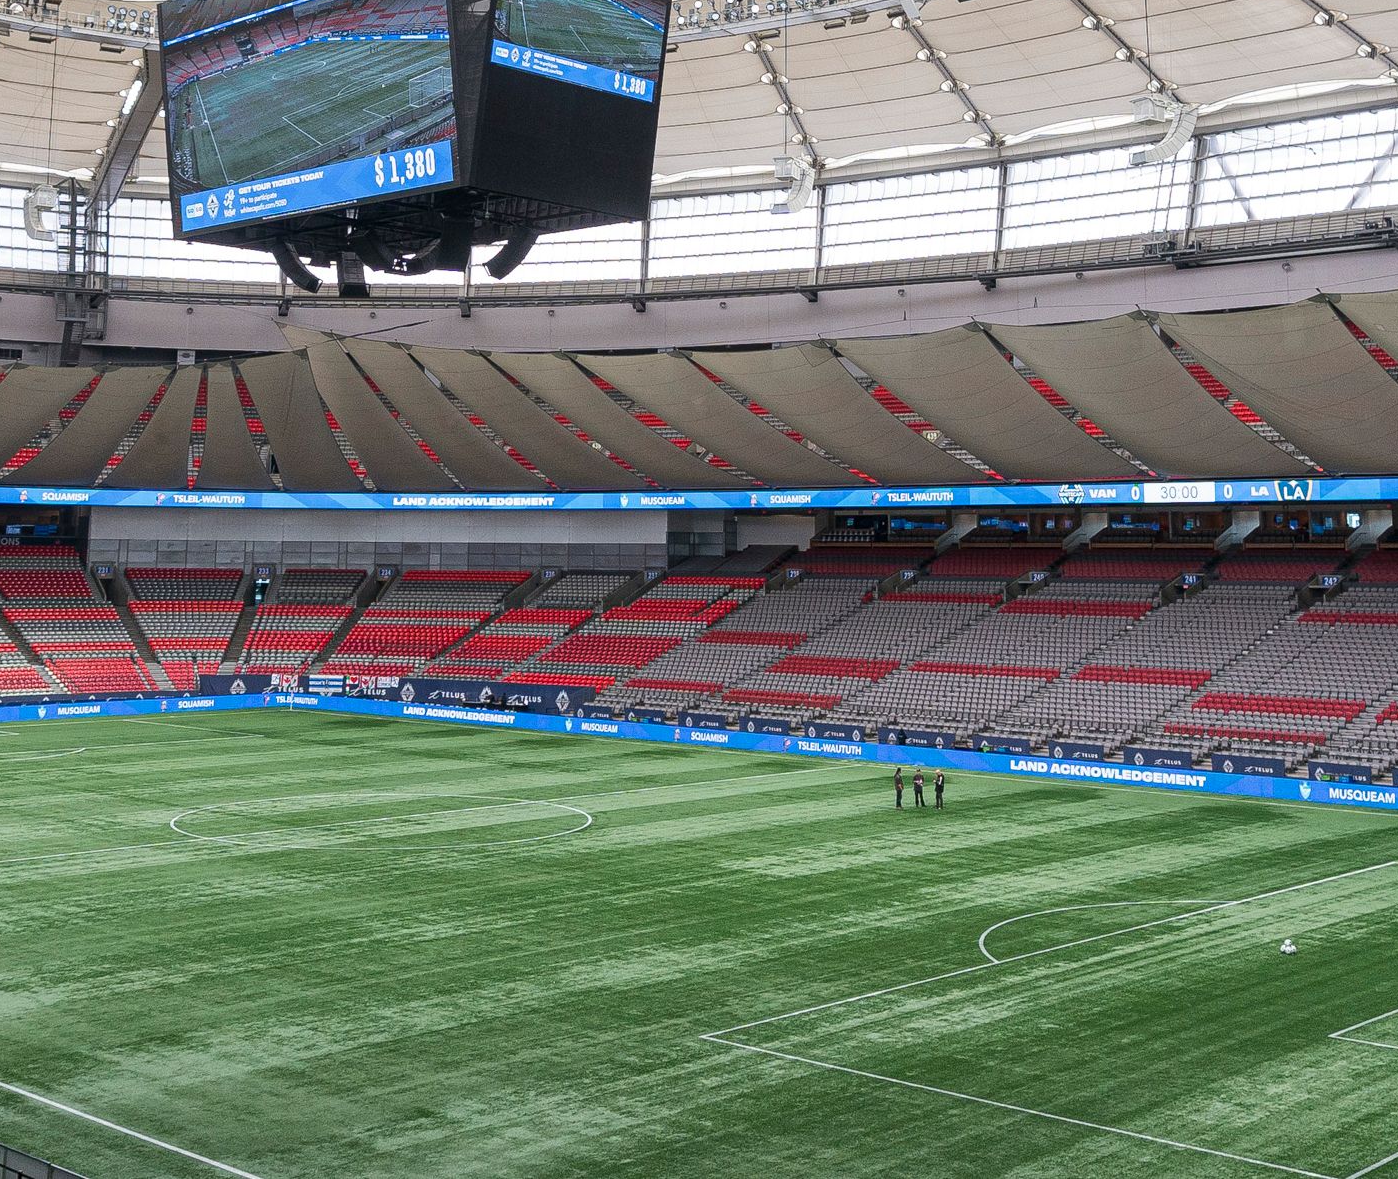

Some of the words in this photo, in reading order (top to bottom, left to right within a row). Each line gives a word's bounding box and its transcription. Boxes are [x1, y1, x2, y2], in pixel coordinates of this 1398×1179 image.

[621, 75, 646, 95] 1,380
[374, 156, 385, 187] $
[389, 148, 435, 186] 1,380
[253, 182, 271, 192] YOUR
[272, 176, 300, 188] TICKETS
[300, 171, 324, 182] TODAY
[42, 491, 89, 502] SQUAMISH
[887, 492, 953, 502] TSLEIL-WAUTUTH
[1089, 488, 1116, 499] VAN
[1131, 486, 1140, 501] 0
[1160, 486, 1199, 500] 30:00
[1223, 485, 1232, 499] 0
[1251, 486, 1269, 496] LA
[1283, 486, 1305, 500] LA
[173, 494, 245, 504] TSLEIL-WAUTUTH
[393, 497, 427, 506] LAND
[429, 497, 554, 506] ACKNOWLEDGEMENT
[640, 496, 685, 506] MUSQUEAM
[769, 494, 811, 504] SQUAMISH
[1184, 574, 1197, 584] 241
[363, 688, 386, 696] TELUS
[441, 691, 466, 699] TELUS
[178, 699, 215, 709] SQUAMISH
[520, 695, 541, 703] TELUS
[57, 705, 101, 715] MUSQUEAM
[403, 706, 431, 716] LAND
[433, 707, 515, 724] ACKNOWLEDGEMENT
[581, 722, 618, 733] MUSQUEAM
[690, 732, 729, 743] SQUAMISH
[797, 741, 862, 756] TSLEIL-WAUTUTH
[1010, 759, 1050, 773] LAND
[1050, 764, 1207, 787] ACKNOWLEDGEMENT
[1329, 787, 1395, 804] MUSQUEAM
